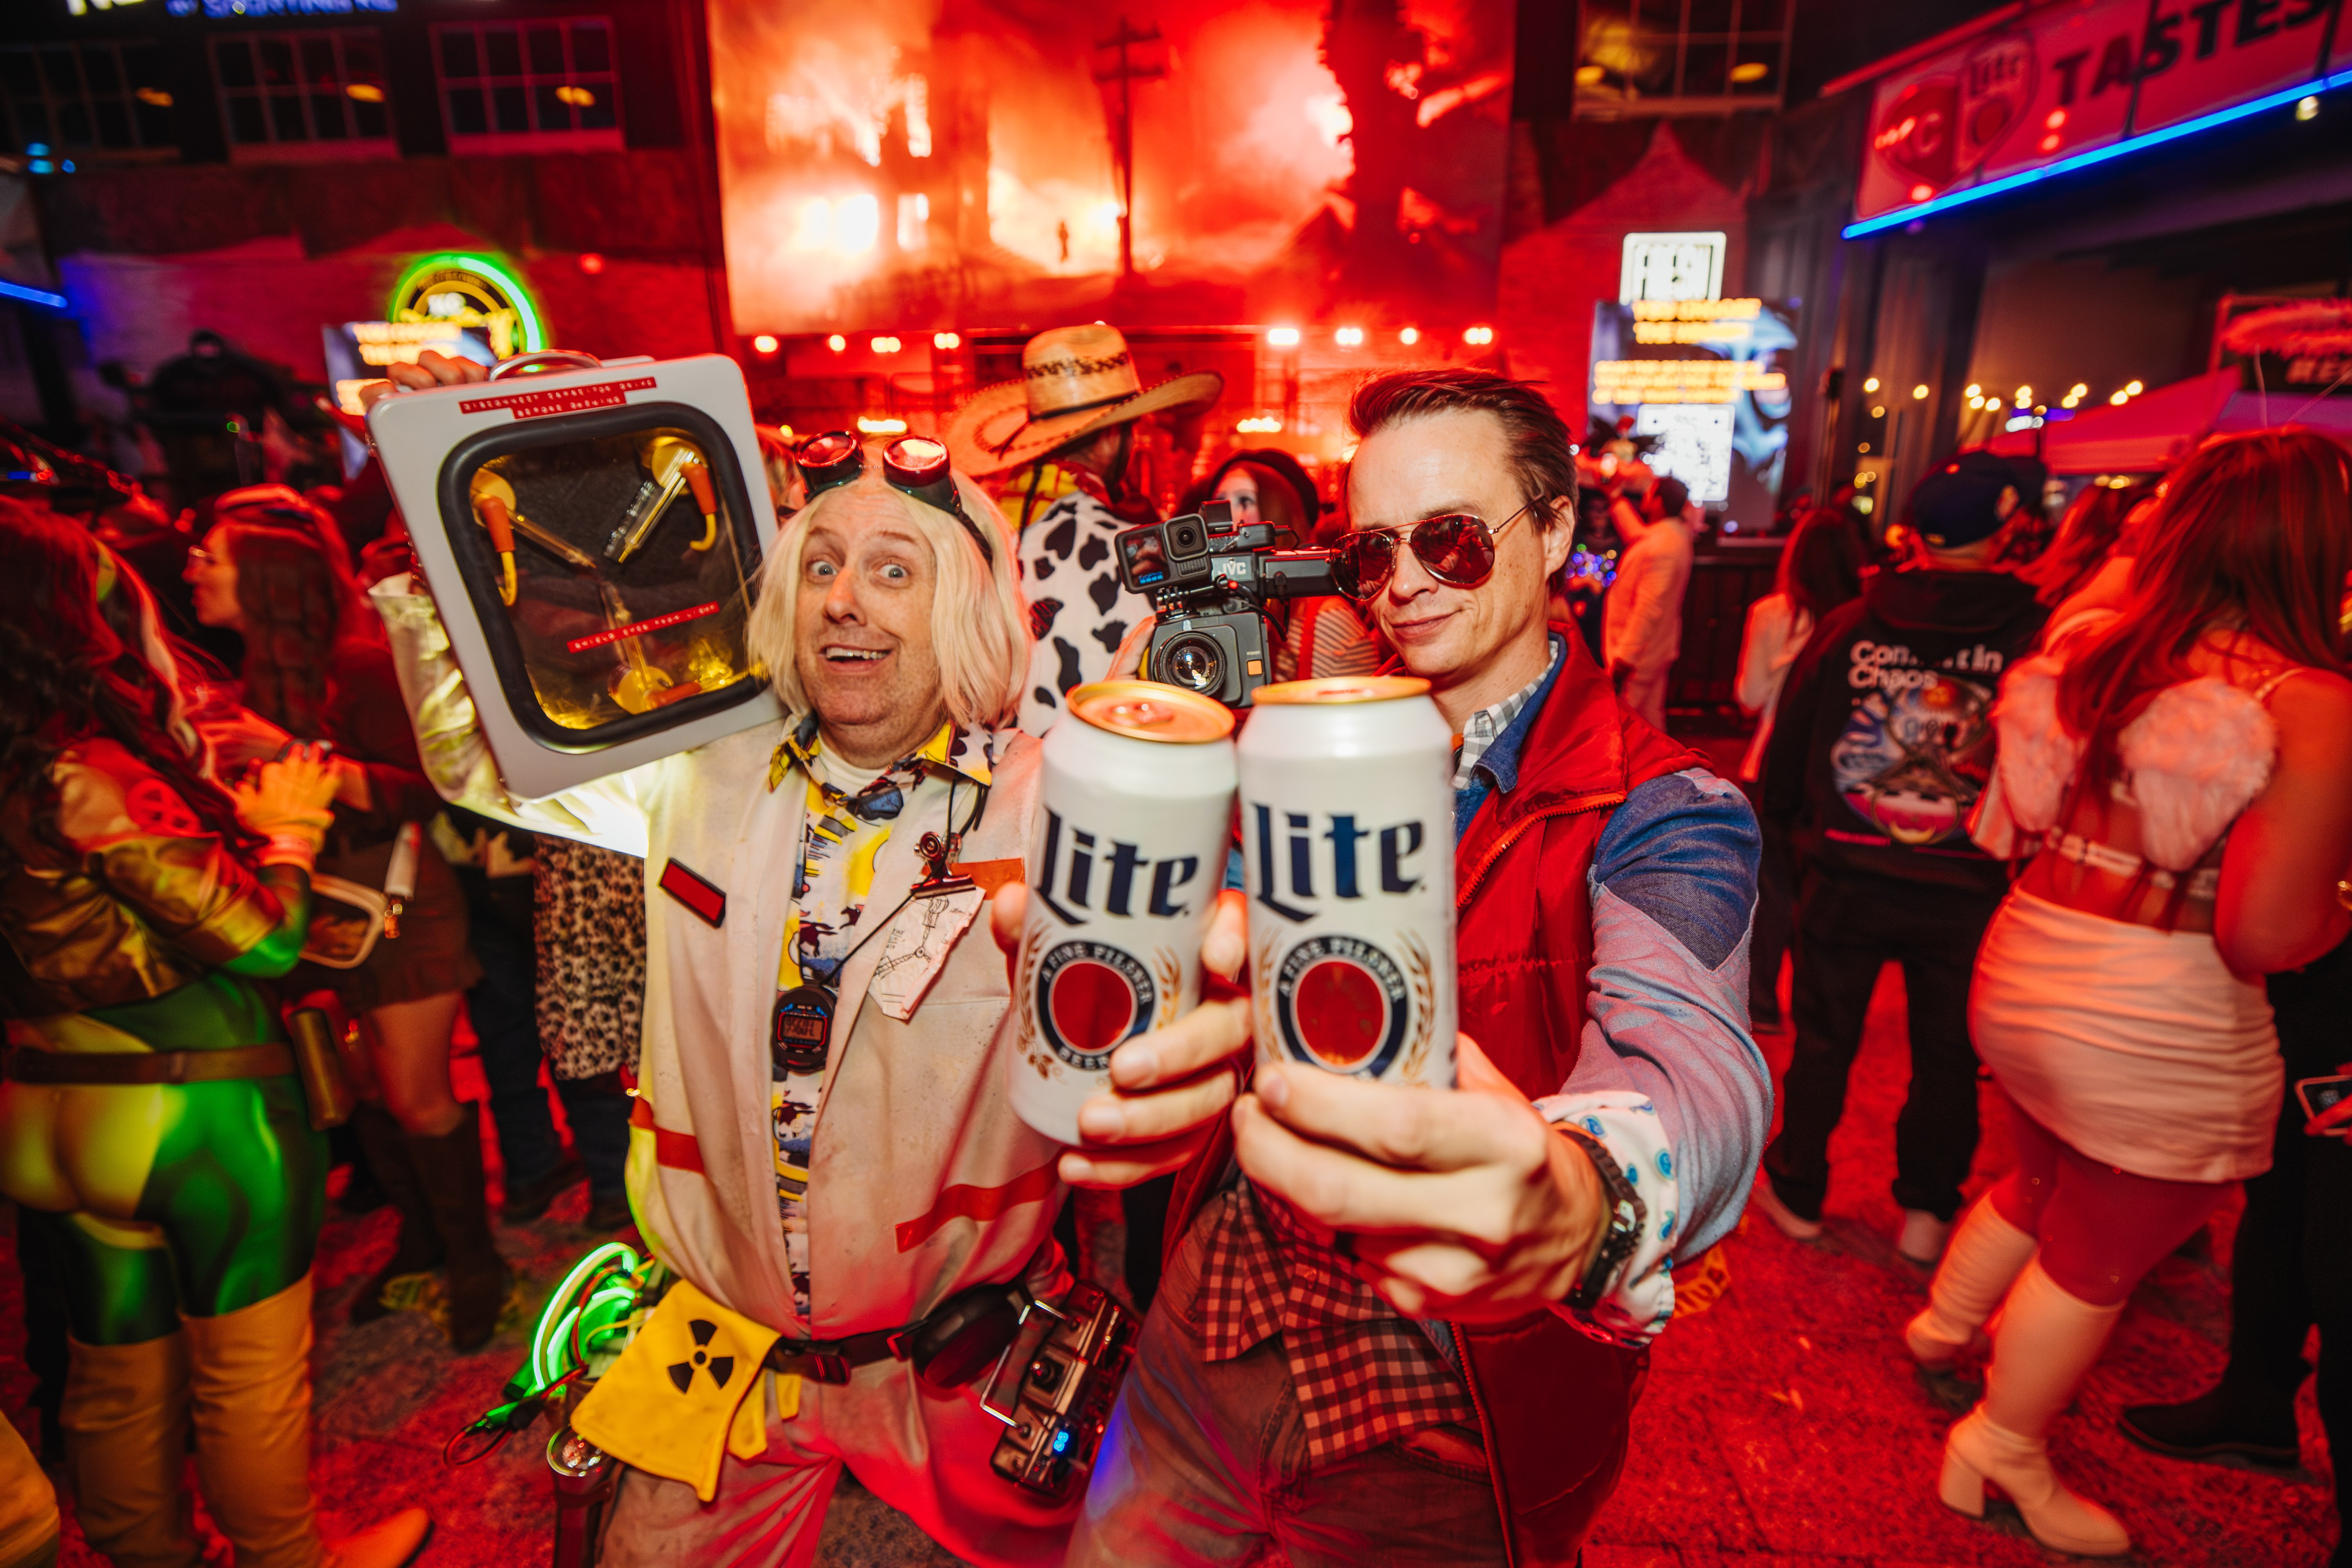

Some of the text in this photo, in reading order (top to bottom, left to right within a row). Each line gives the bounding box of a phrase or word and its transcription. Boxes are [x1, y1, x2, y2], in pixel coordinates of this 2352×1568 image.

[463, 379, 652, 410] DISCONNECT CAPACITOR DRIVE
[517, 396, 621, 417] BEFORE OPENING
[1218, 561, 1247, 575] JVC
[574, 632, 615, 649] SHIELD
[622, 623, 649, 636] EYES
[654, 614, 680, 625] FROM
[1847, 663, 1939, 691] Chaos
[1033, 806, 1198, 925] Lite
[1251, 802, 1426, 923] Lite
[1041, 942, 1154, 1005] A FINE PILSNER
[1278, 938, 1406, 1004] A FINE PILSNER
[1058, 1045, 1109, 1071] BEER
